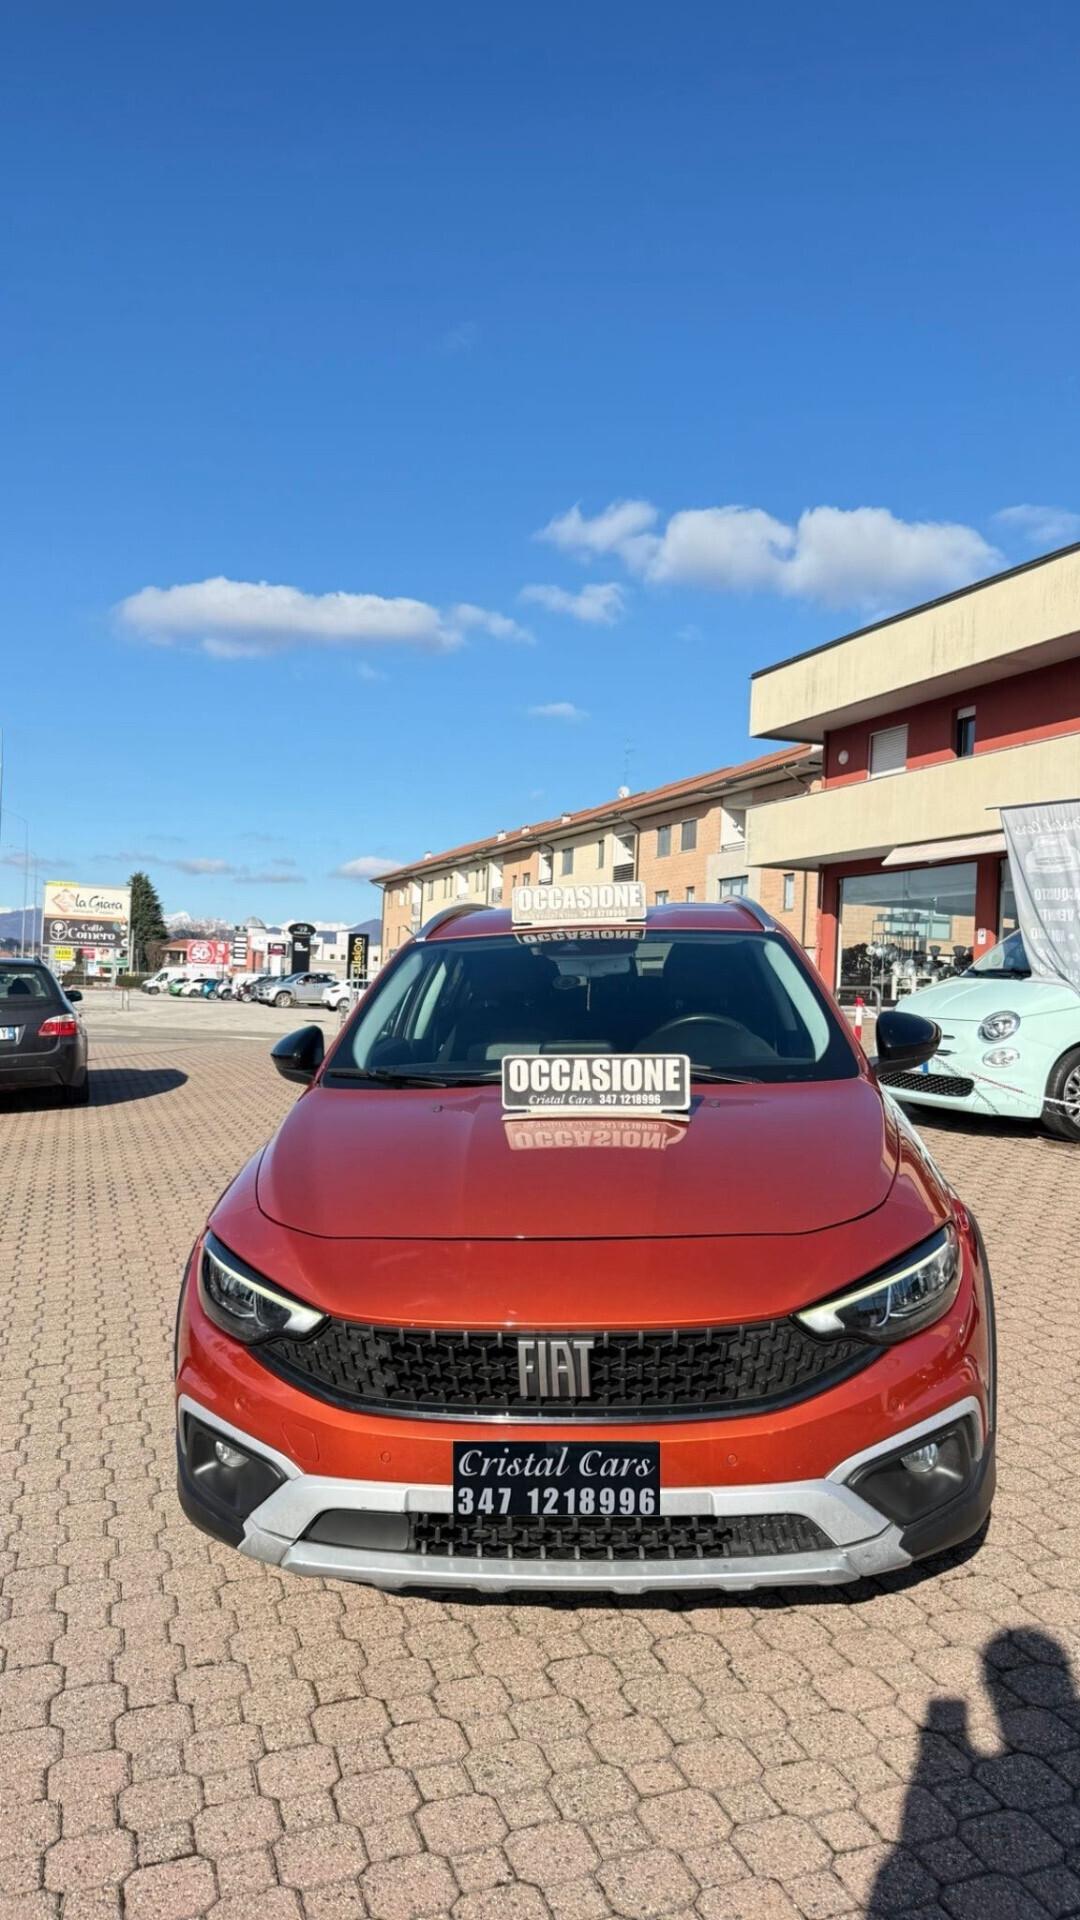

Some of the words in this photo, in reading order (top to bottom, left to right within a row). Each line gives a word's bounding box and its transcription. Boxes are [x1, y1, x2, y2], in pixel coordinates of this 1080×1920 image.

[519, 885, 641, 911] OCCASIONE
[509, 1059, 681, 1092] OCCASIONE
[528, 1094, 565, 1105] Cristal
[568, 1094, 594, 1105] Cars
[599, 1094, 617, 1105] 347
[620, 1094, 661, 1105] 1218996
[517, 1340, 595, 1397] FIAT
